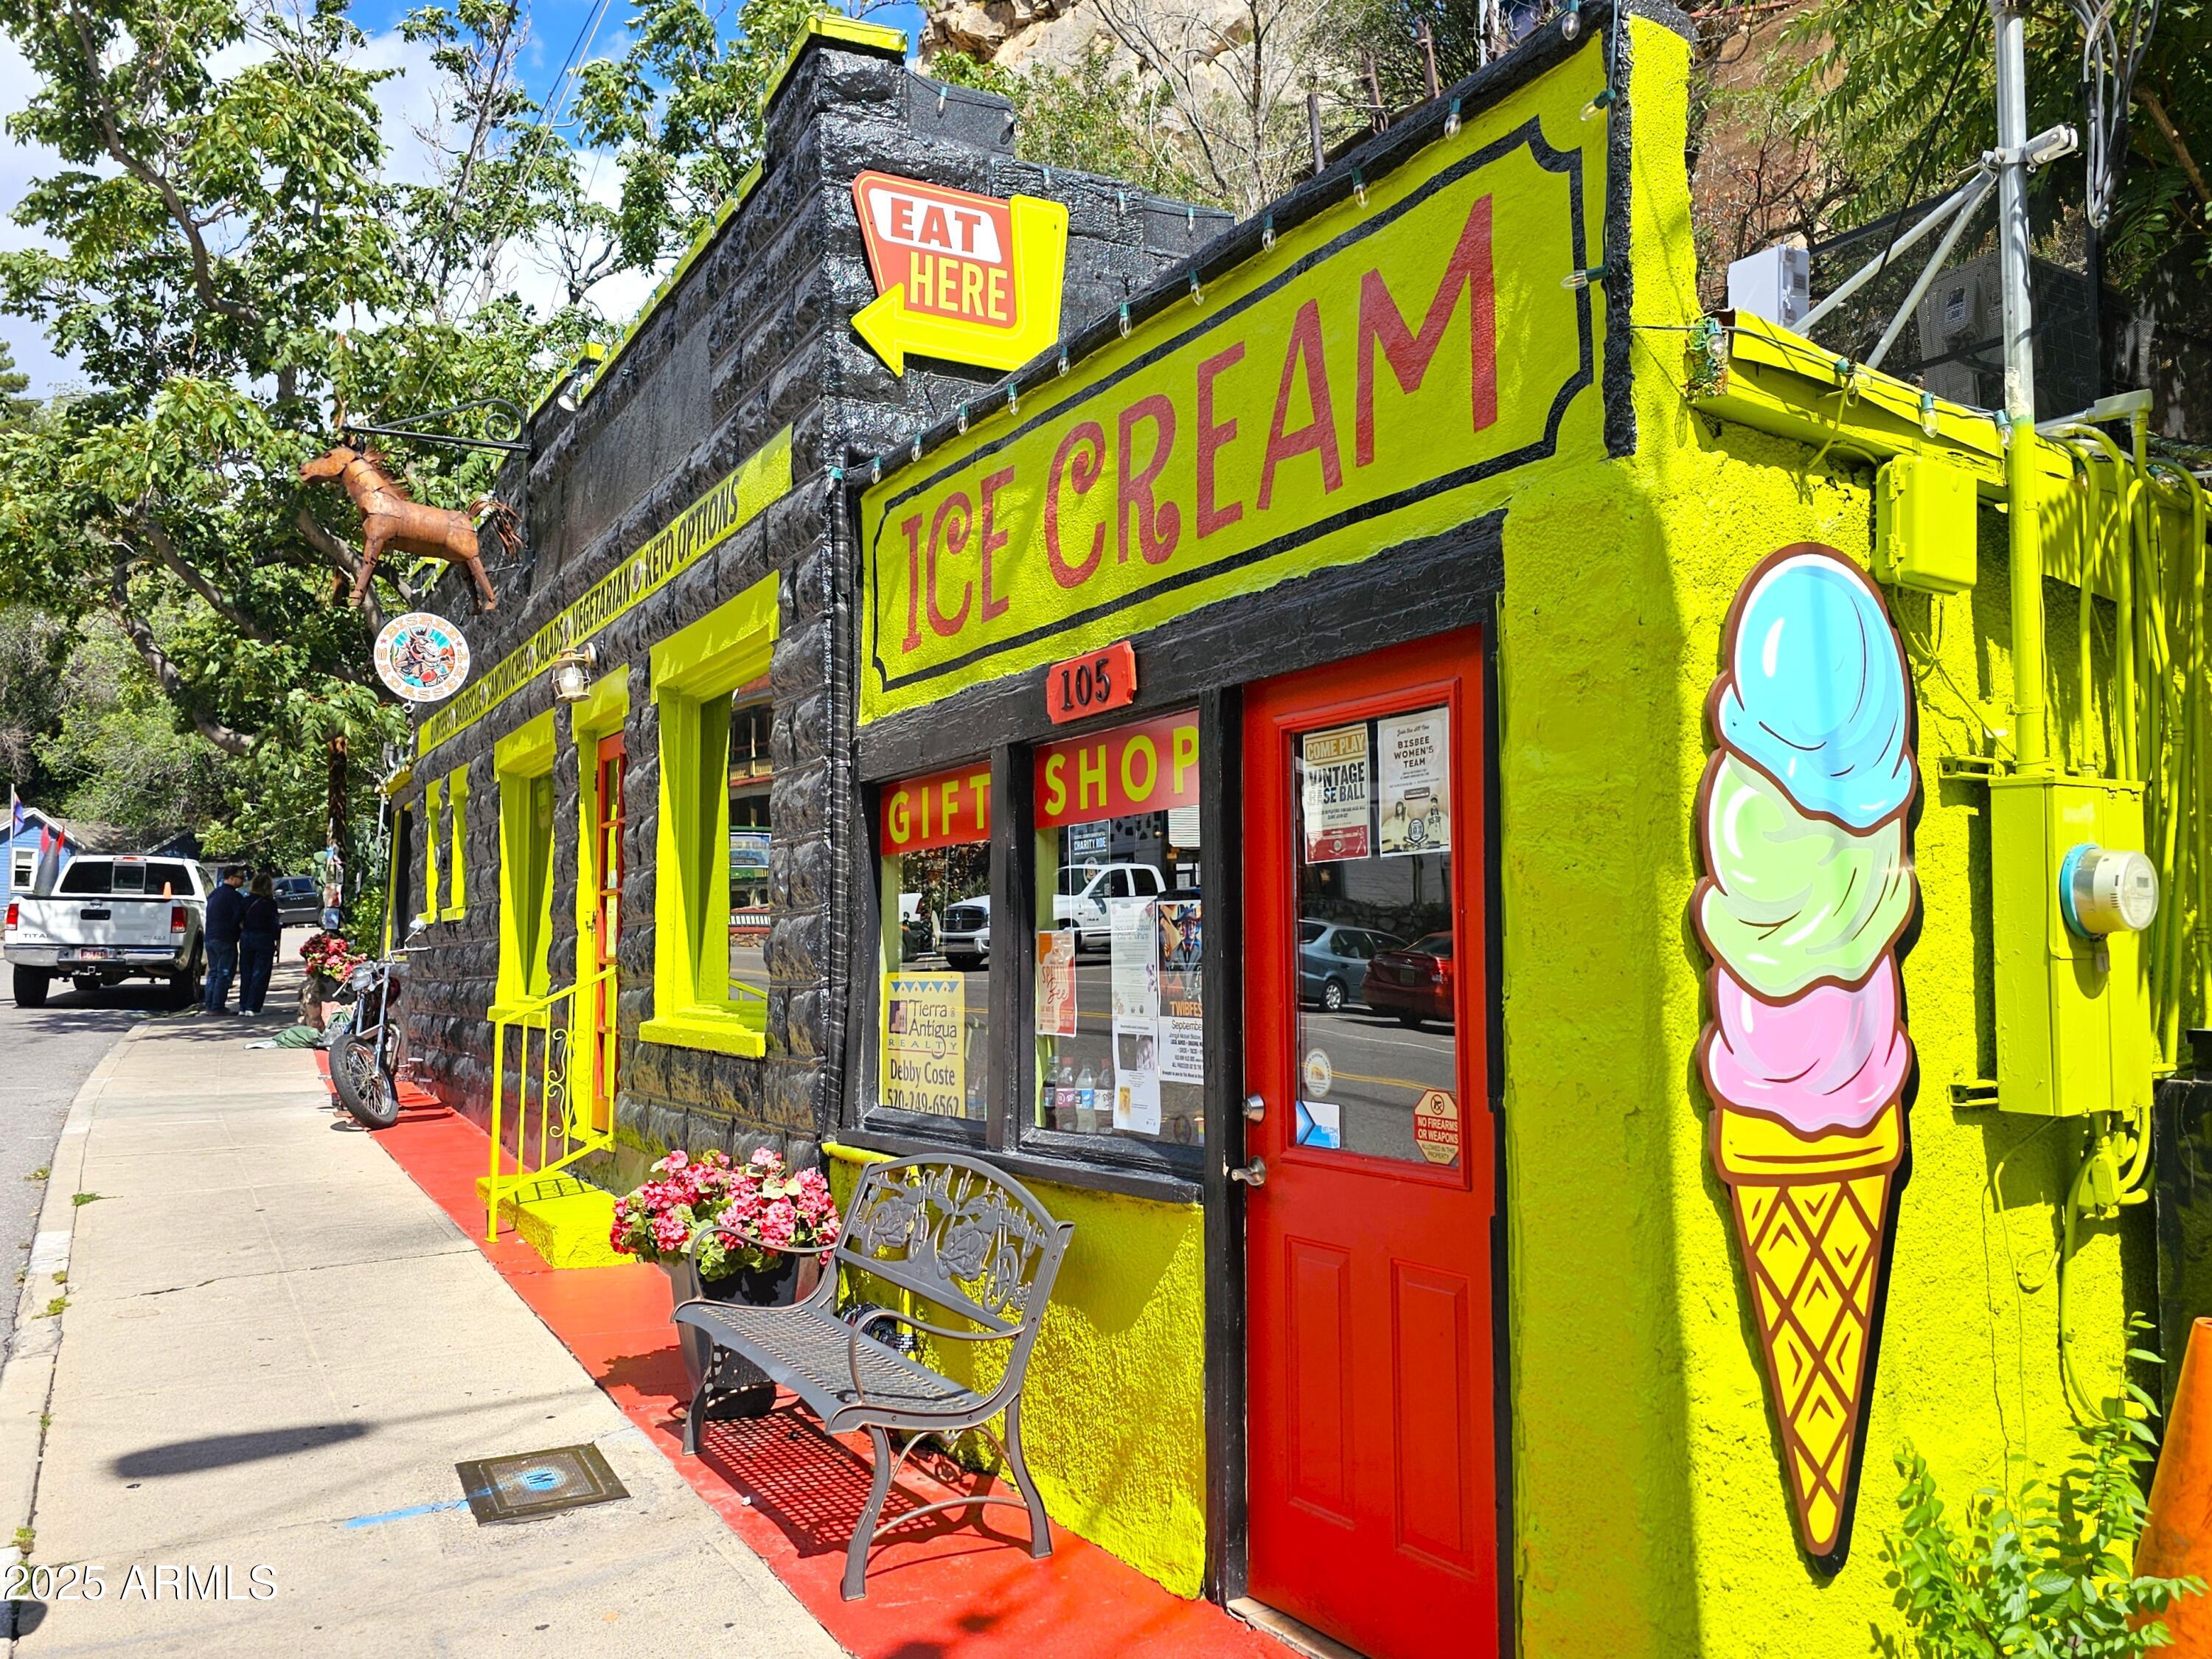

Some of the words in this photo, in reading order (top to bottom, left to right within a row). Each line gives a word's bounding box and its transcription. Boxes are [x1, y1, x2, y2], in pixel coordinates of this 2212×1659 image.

[891, 197, 981, 253] EAT
[910, 251, 1008, 321] HERE
[901, 465, 1015, 655] ICE
[1045, 192, 1499, 588] CREAM
[487, 645, 529, 706] SANDWICHES
[535, 620, 564, 669] SALADS
[571, 563, 631, 641] VEGETARIAN
[644, 529, 675, 590] KETO
[677, 474, 740, 563] OPTIONS
[383, 614, 461, 641] BISBEE
[1061, 656, 1112, 713] 105
[1307, 739, 1338, 760] COME
[1339, 734, 1365, 756] PLAY
[1394, 745, 1434, 759] WOMEN'S
[1397, 736, 1430, 749] BISBEE
[1308, 761, 1365, 788] VINTAGE
[1403, 757, 1425, 768] TEAM
[888, 772, 991, 845] GIFT
[1044, 726, 1200, 816] SHOP
[1309, 787, 1337, 806] BASE
[1339, 782, 1366, 803] BALL
[1074, 838, 1095, 850] CHARITY
[908, 999, 947, 1018] Tierra
[888, 1039, 958, 1050] REALTY
[908, 1019, 957, 1060] Antigua
[891, 1058, 922, 1088] Debby
[924, 1061, 956, 1086] Coste
[1417, 1116, 1427, 1127] NO
[1427, 1117, 1458, 1132] FIREARMS
[1418, 1128, 1427, 1139] OR
[1427, 1130, 1458, 1144] WEAPONS
[1422, 1143, 1441, 1151] ALLOWED
[1427, 1151, 1450, 1161] PROPERTY
